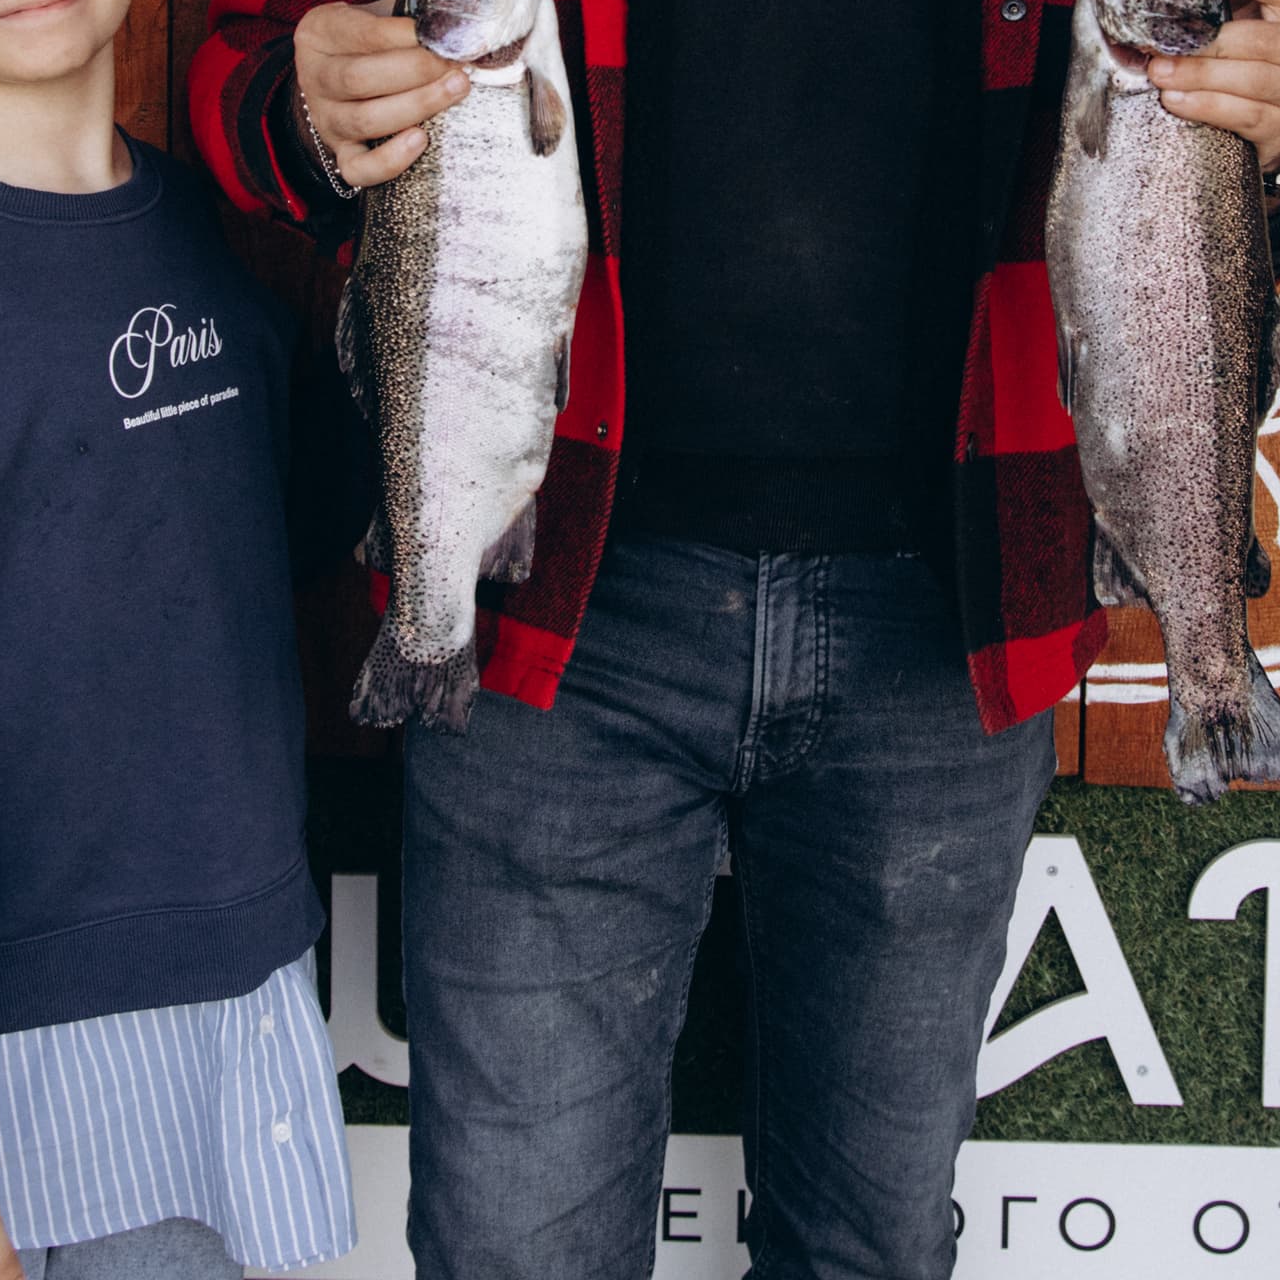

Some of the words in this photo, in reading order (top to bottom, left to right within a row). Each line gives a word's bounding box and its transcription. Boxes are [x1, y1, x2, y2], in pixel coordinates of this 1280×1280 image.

[109, 303, 222, 399] Paris
[123, 409, 161, 429] Beautiful
[160, 405, 178, 418] little
[178, 399, 200, 416] piece
[200, 394, 209, 407] of
[210, 386, 239, 406] paradise
